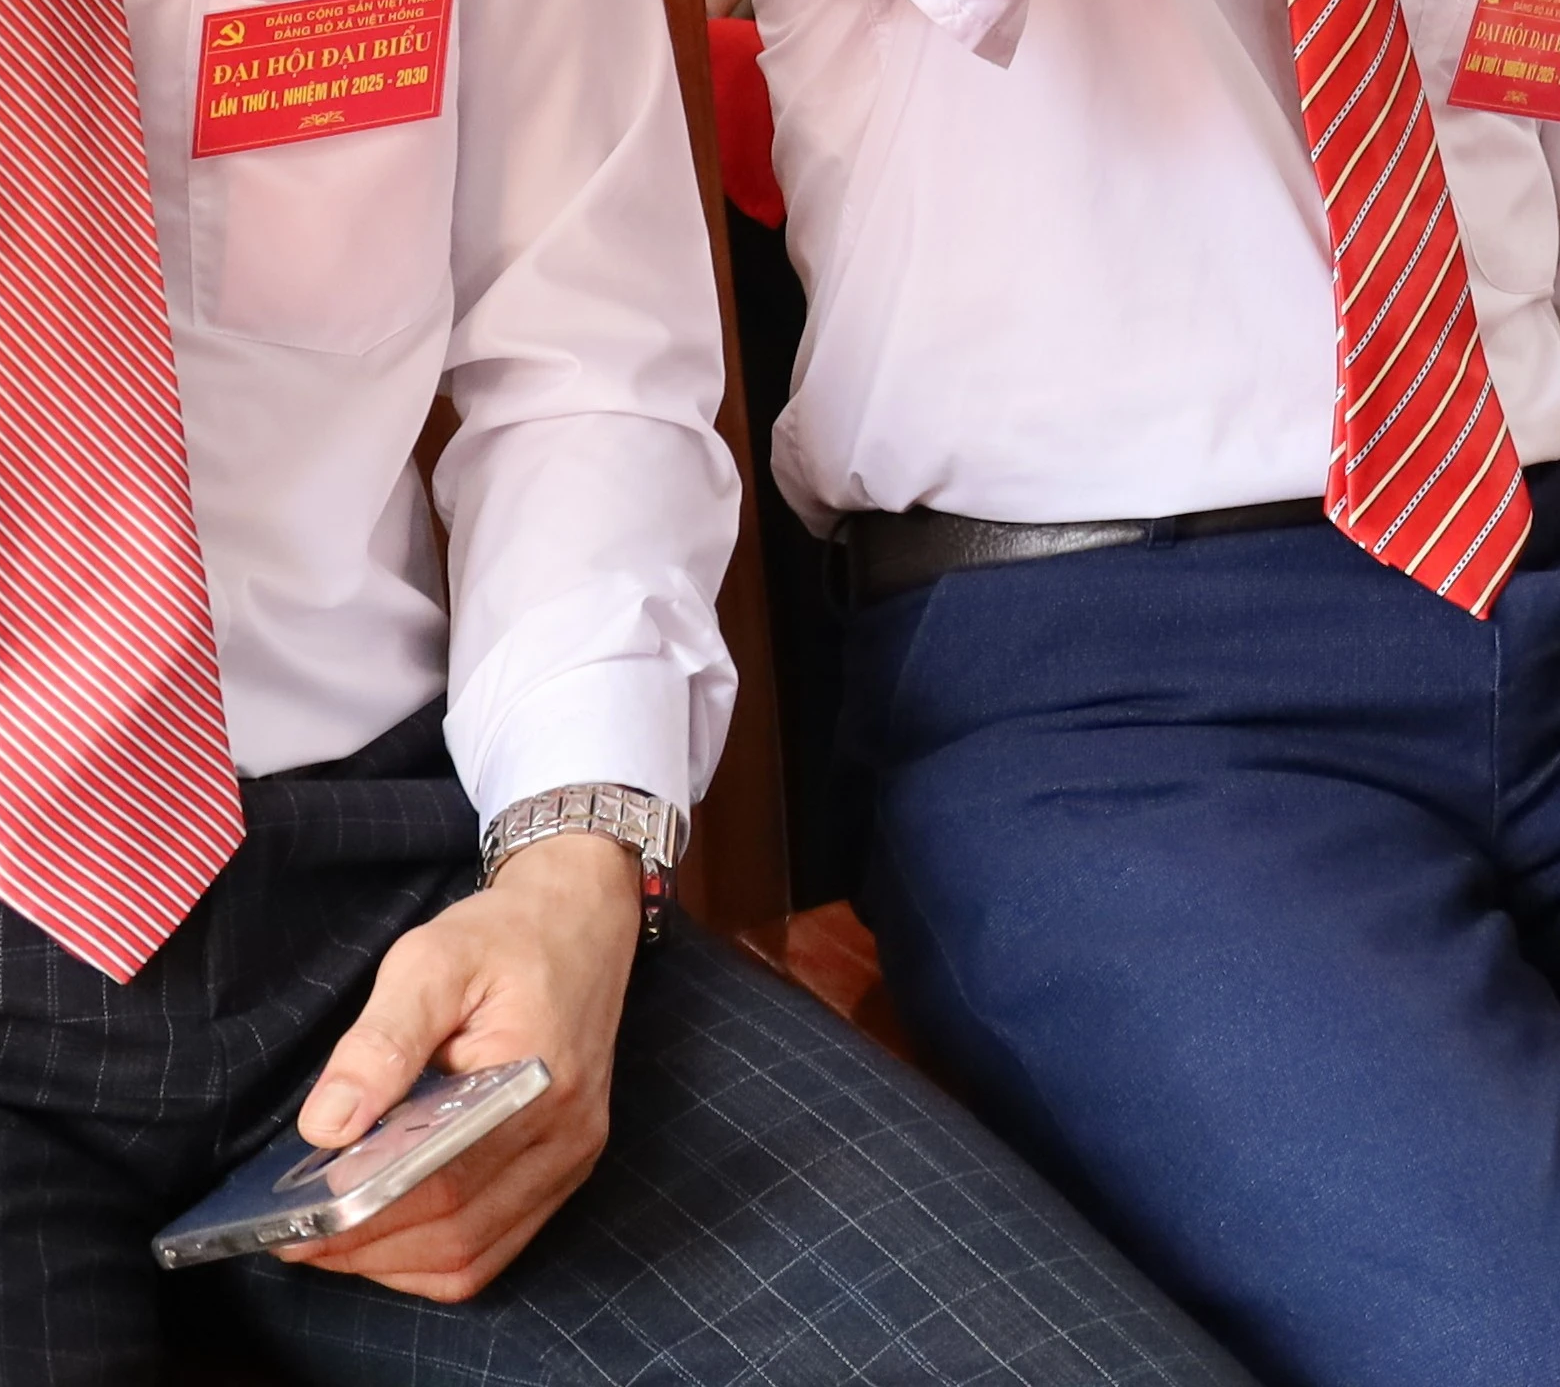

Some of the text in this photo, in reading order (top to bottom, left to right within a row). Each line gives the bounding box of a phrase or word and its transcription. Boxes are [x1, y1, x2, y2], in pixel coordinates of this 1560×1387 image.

[265, 12, 303, 28] ĐẢNG
[306, 6, 343, 21] CỘNG
[347, 0, 373, 15] SẢN
[274, 26, 311, 41] ĐẢNG
[315, 21, 334, 34] BỘ
[336, 18, 354, 31] XÃ
[357, 13, 385, 27] VIỆT
[212, 25, 432, 87] ĐẠI HỘI ĐẠI BIỂU
[210, 92, 238, 119] LẦN
[242, 88, 270, 113] THỨ
[283, 80, 327, 107] NHIỆM
[331, 75, 348, 98] KỲ
[351, 73, 384, 95] 2025
[396, 65, 429, 88] 2030
